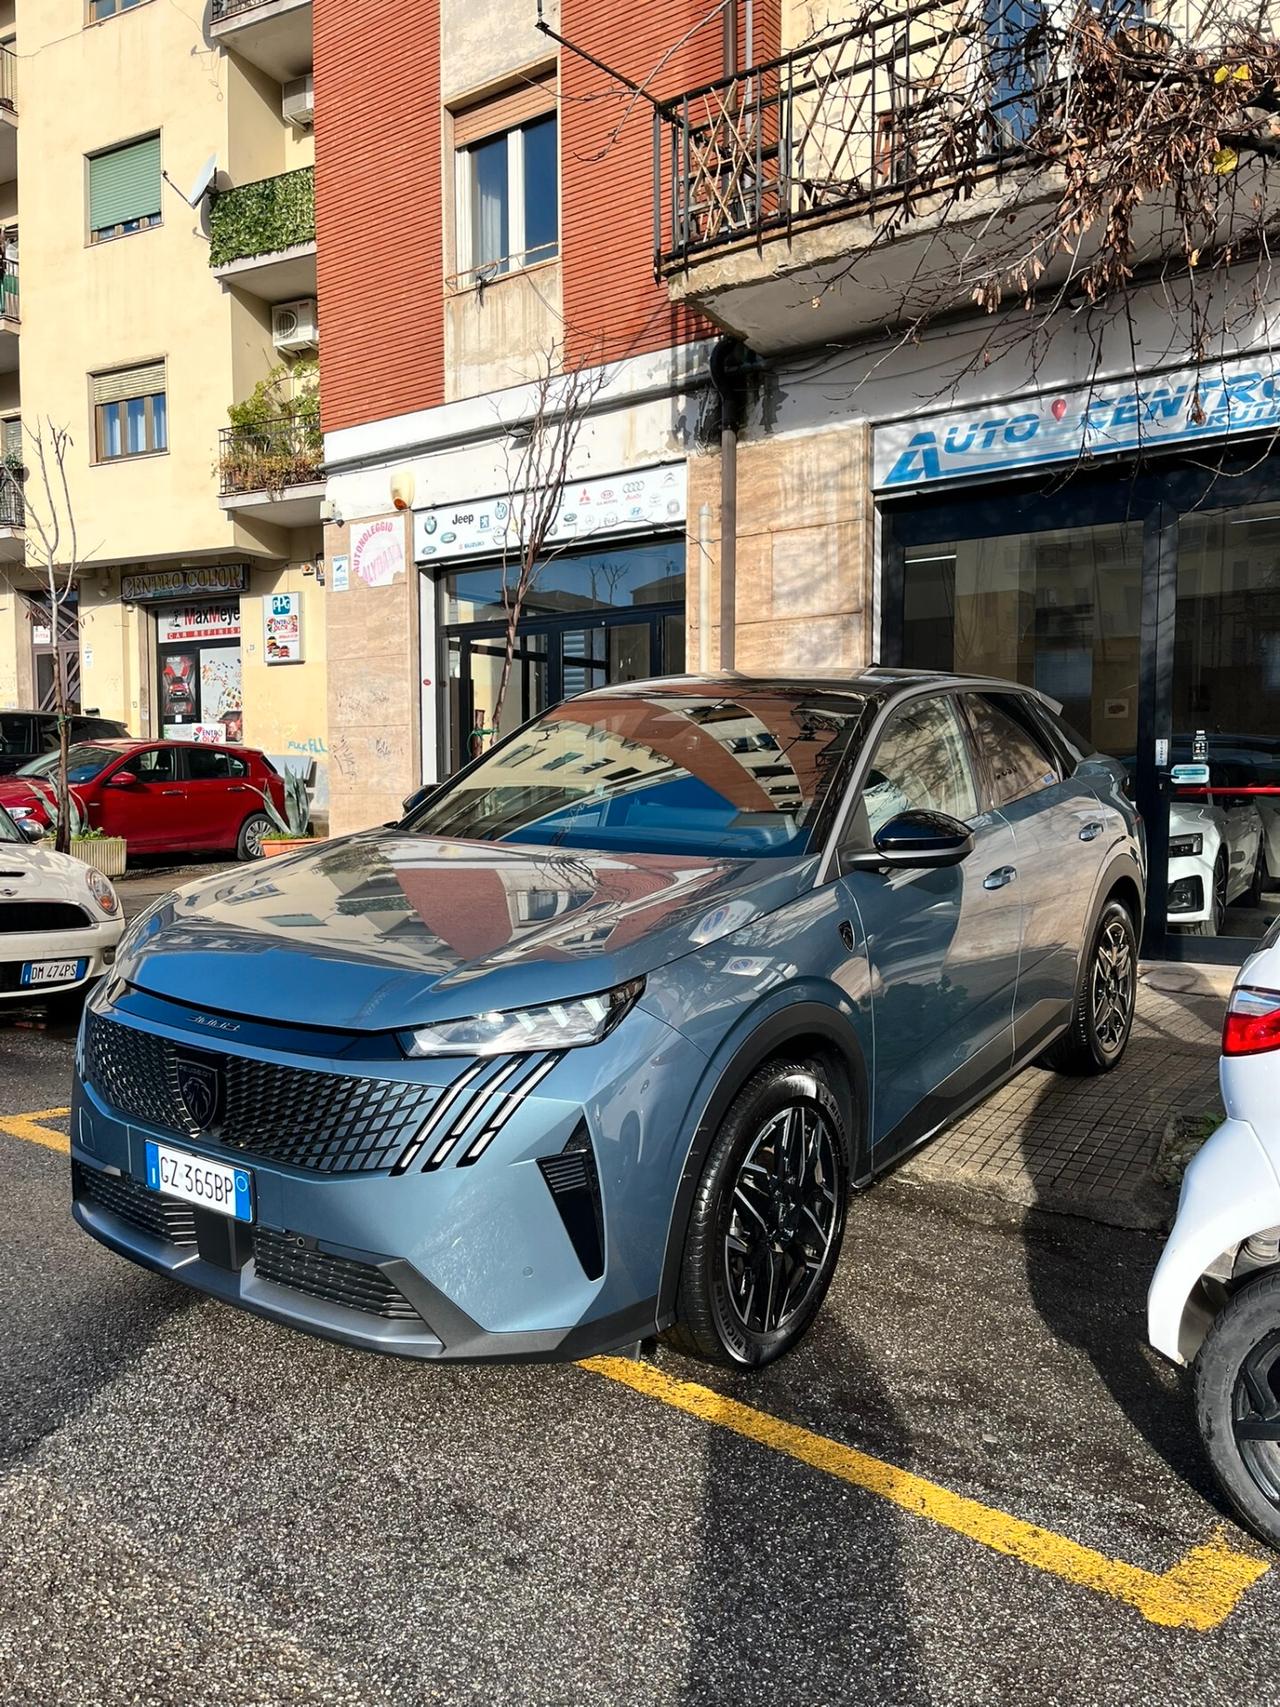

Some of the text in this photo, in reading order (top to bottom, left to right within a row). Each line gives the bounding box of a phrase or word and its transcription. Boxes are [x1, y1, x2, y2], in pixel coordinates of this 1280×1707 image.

[883, 413, 1041, 485] AUTO
[452, 513, 475, 525] Jeep
[352, 521, 394, 573] AUTONOLEGGIO
[124, 565, 241, 599] CENTRO COLOR
[273, 596, 290, 612] PPG
[168, 632, 188, 640] CAR
[31, 964, 77, 980] DM 474PS
[184, 1163, 234, 1205] 365BP
